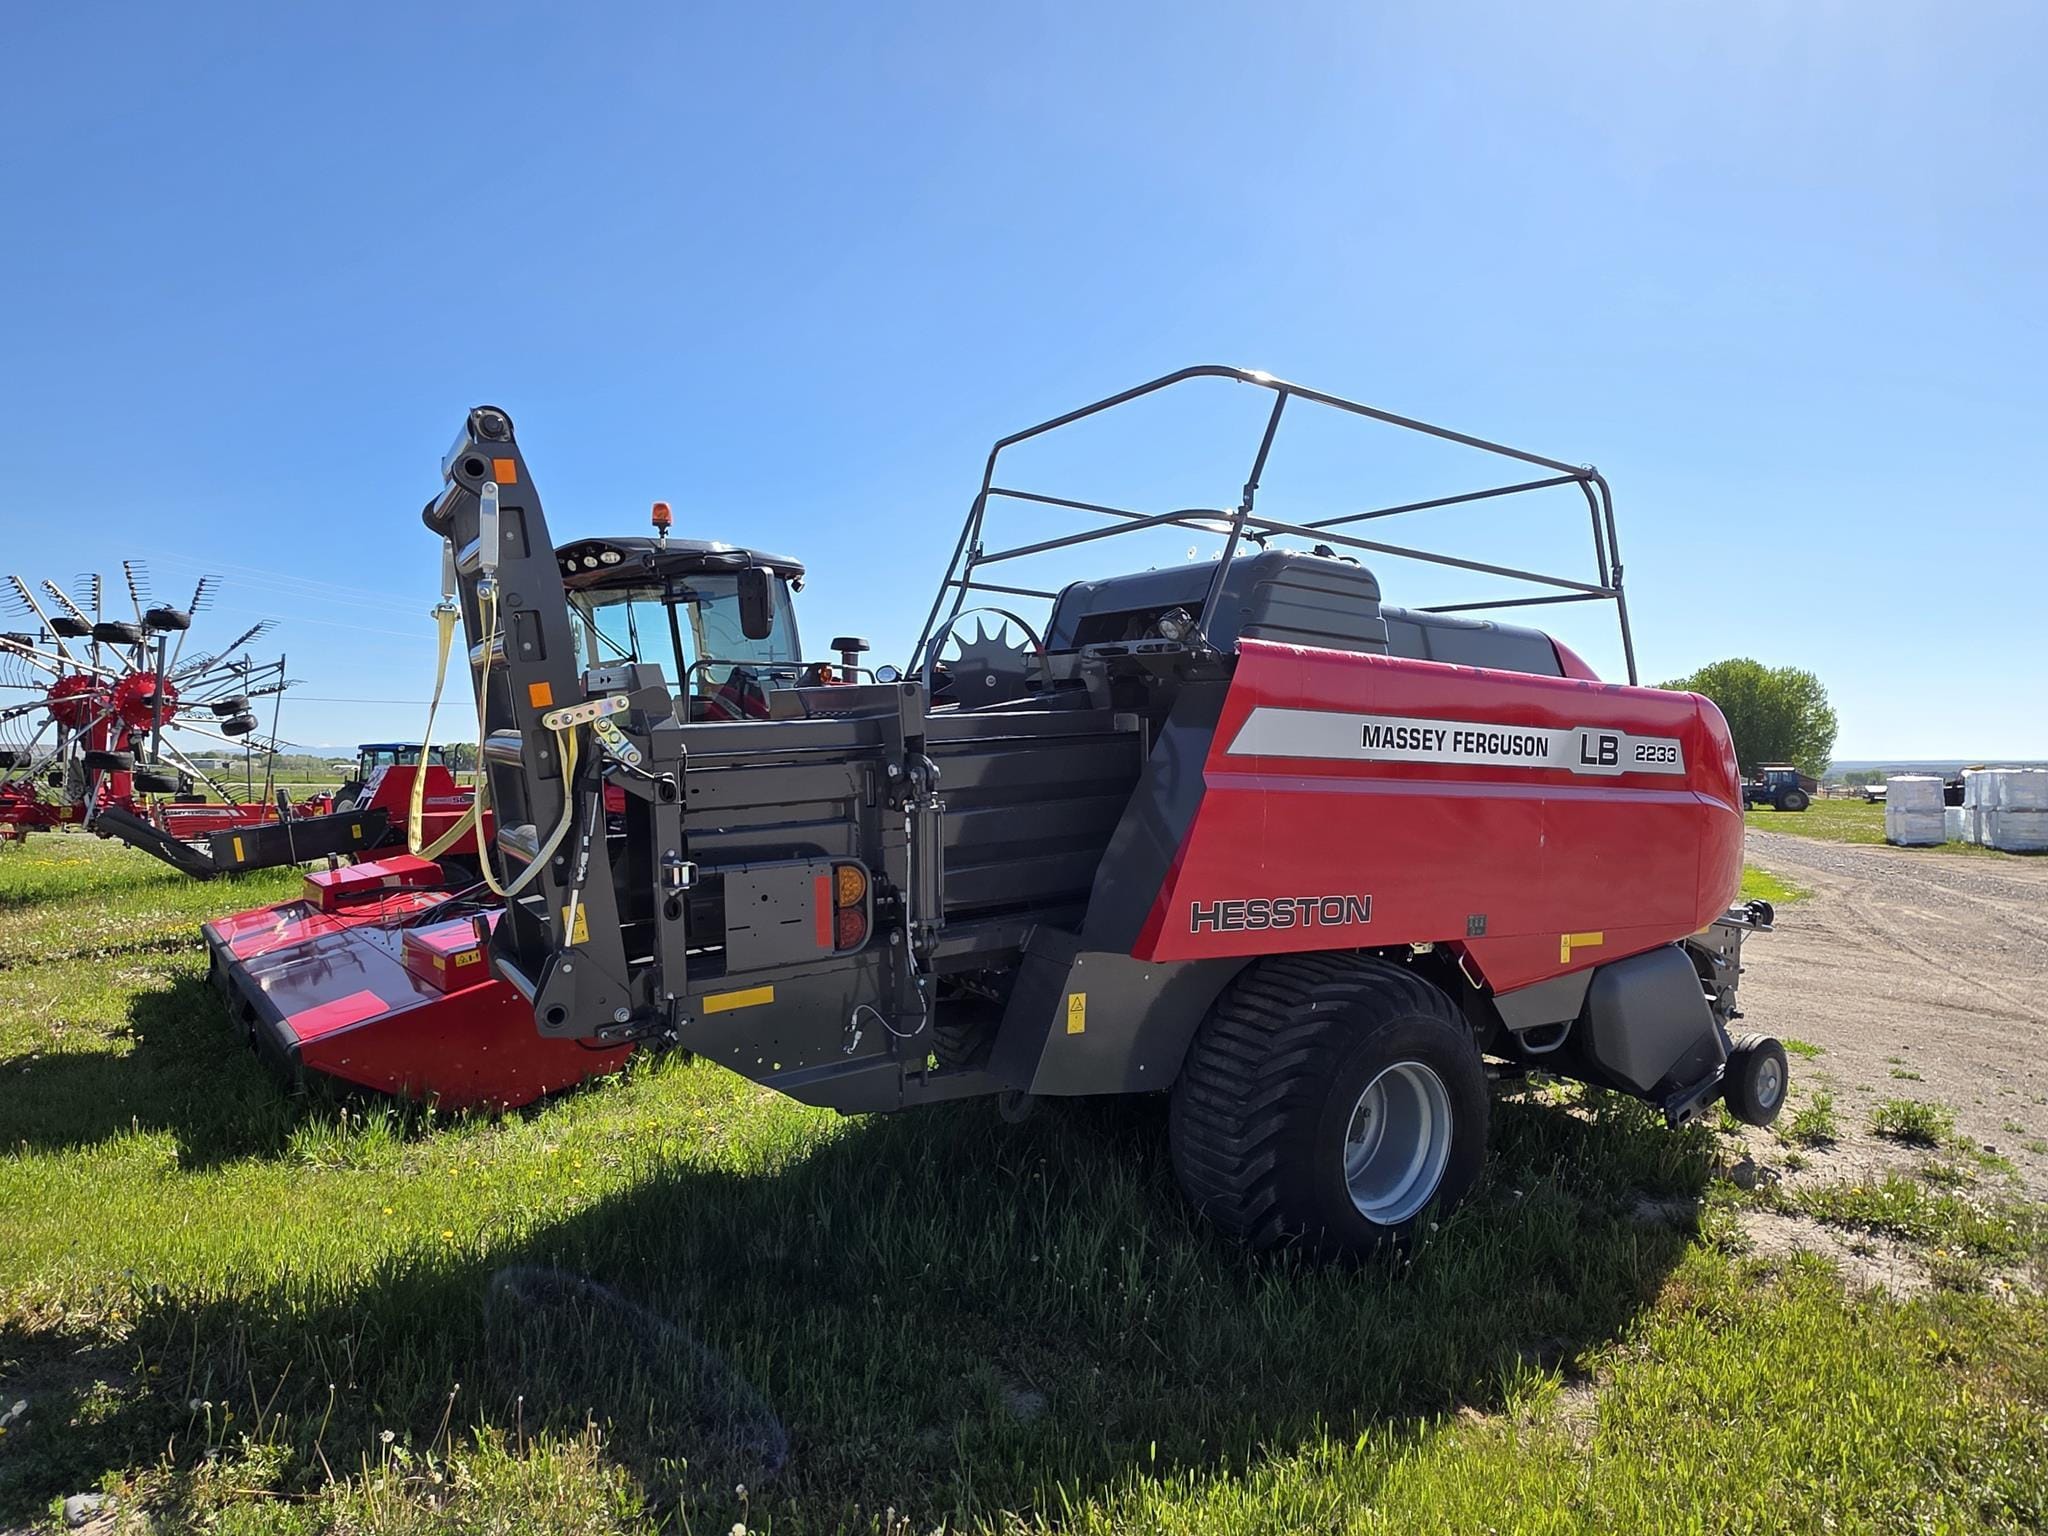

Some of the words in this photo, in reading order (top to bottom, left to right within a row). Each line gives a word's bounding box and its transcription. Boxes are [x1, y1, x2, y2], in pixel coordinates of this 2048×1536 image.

[1361, 724, 1447, 752] MASSEY
[1452, 731, 1549, 757] FERGUSON
[1580, 732, 1619, 767] LB
[1635, 744, 1677, 763] 2233
[1190, 894, 1372, 933] HESSTON
